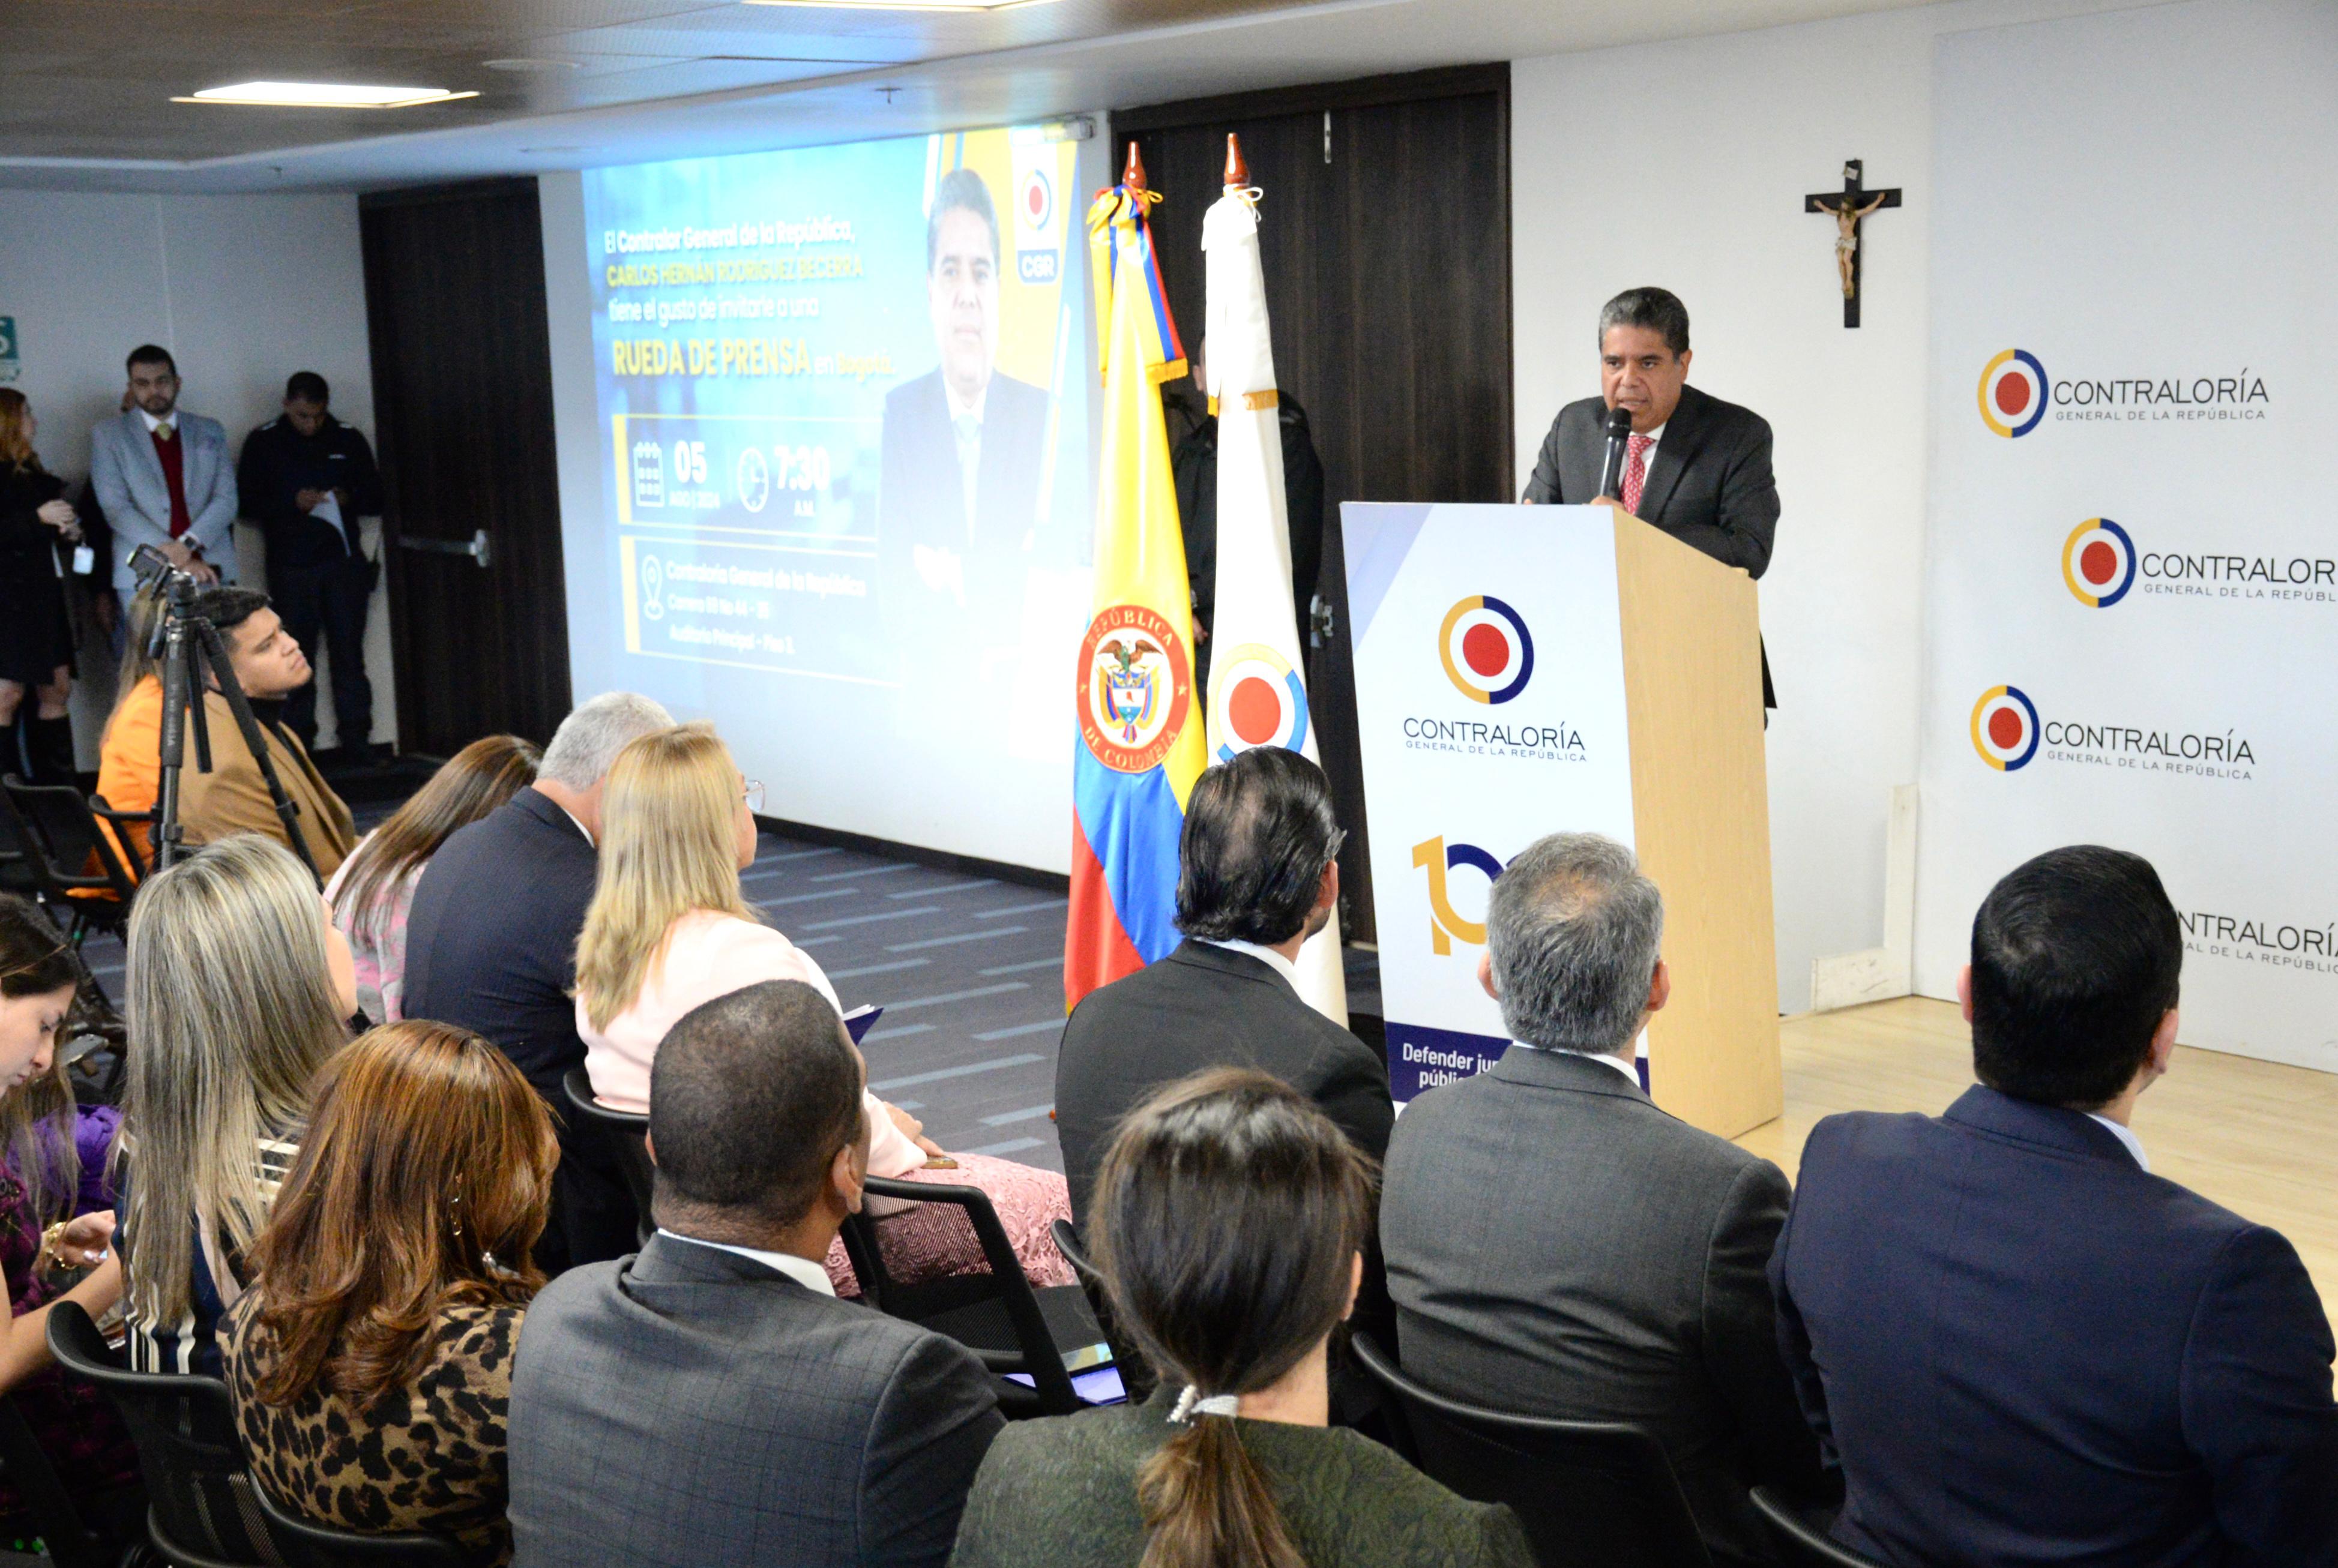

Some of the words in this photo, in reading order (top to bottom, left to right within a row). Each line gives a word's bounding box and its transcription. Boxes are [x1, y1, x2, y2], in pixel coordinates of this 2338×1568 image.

[604, 231, 616, 253] El
[617, 228, 681, 253] Contralor
[683, 222, 737, 249] General
[740, 221, 757, 245] de
[759, 221, 775, 244] la
[777, 214, 855, 251] República,
[607, 262, 658, 287] CARLOS
[660, 254, 715, 284] HERNÁN
[717, 252, 794, 283] RODRÍGUEZ
[796, 252, 864, 280] BECERRA
[1022, 254, 1055, 278] CGR
[609, 299, 642, 322] tiene
[643, 298, 657, 320] el
[658, 298, 696, 328] gusto
[699, 296, 716, 319] de
[718, 293, 774, 319] invitarle
[777, 301, 788, 318] a
[790, 297, 819, 317] una
[612, 338, 685, 376] RUEDA
[688, 338, 718, 376] DE
[720, 337, 812, 376] PRENSA
[815, 356, 834, 375] en
[2054, 367, 2269, 405] CONTRALORÍA
[2056, 411, 2121, 421] GENERAL
[2128, 410, 2146, 420] DE
[2153, 410, 2170, 420] LA
[2177, 407, 2265, 420] REPÚBLICA
[673, 440, 707, 484] 05
[774, 444, 831, 491] 7:30
[2144, 584, 2212, 596] GENERAL
[2220, 587, 2238, 597] DE
[2246, 589, 2264, 598] LA
[1086, 607, 1172, 649] REPÚBLICA
[1104, 730, 1178, 769] COLOMBIA
[1404, 718, 1585, 751] CONTRALORÍA
[1406, 740, 1463, 753] GENERAL
[1469, 745, 1484, 754] DE
[1511, 748, 1586, 762] REPÚBLICA
[2046, 721, 2255, 765] CONTRALORÍA
[2047, 751, 2111, 765] GENERAL
[2118, 757, 2136, 767] DE
[2142, 760, 2159, 770] LA
[2166, 762, 2252, 781] REPÚBLICA
[2178, 910, 2338, 957] NTRALORÍ
[2210, 945, 2229, 957] DE
[2237, 949, 2254, 960] LA
[1403, 1042, 1474, 1070] Defender
